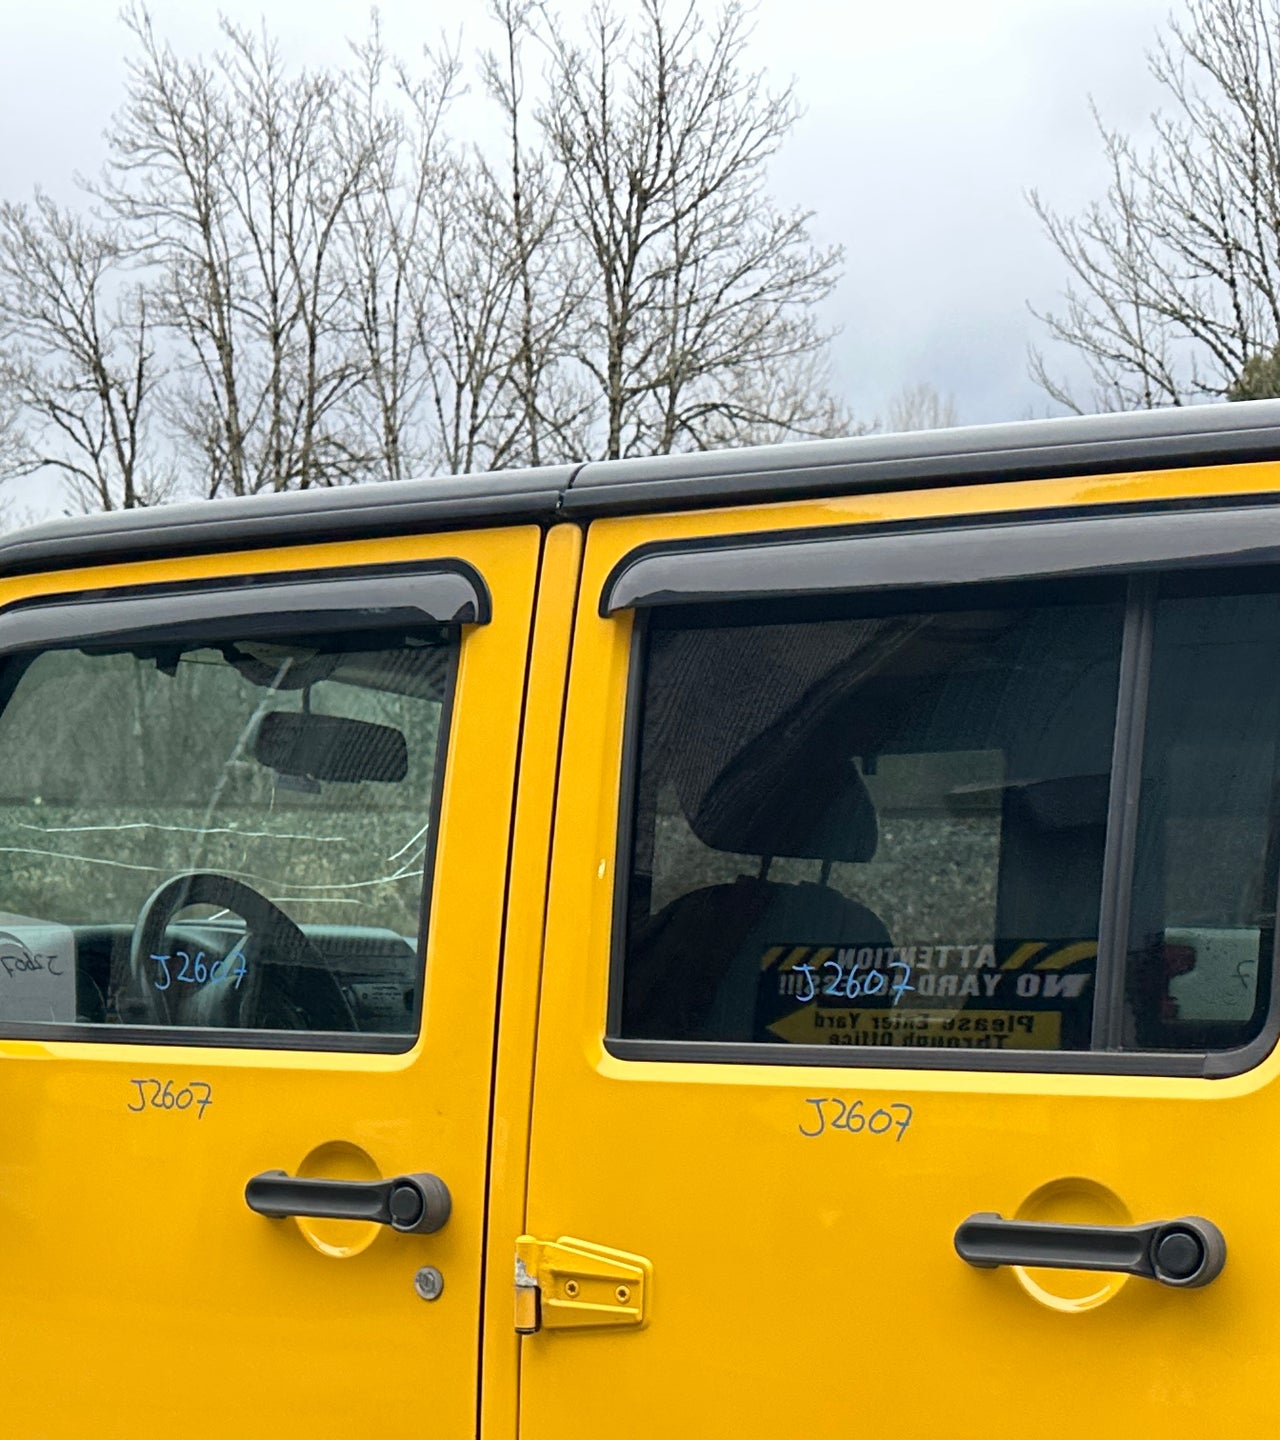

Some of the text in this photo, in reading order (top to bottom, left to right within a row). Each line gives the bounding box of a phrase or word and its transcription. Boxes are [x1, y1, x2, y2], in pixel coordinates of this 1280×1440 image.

[150, 951, 248, 990] J2607
[792, 961, 916, 1005] J2607
[128, 1079, 213, 1120] J2607
[798, 1097, 913, 1142] J2607
